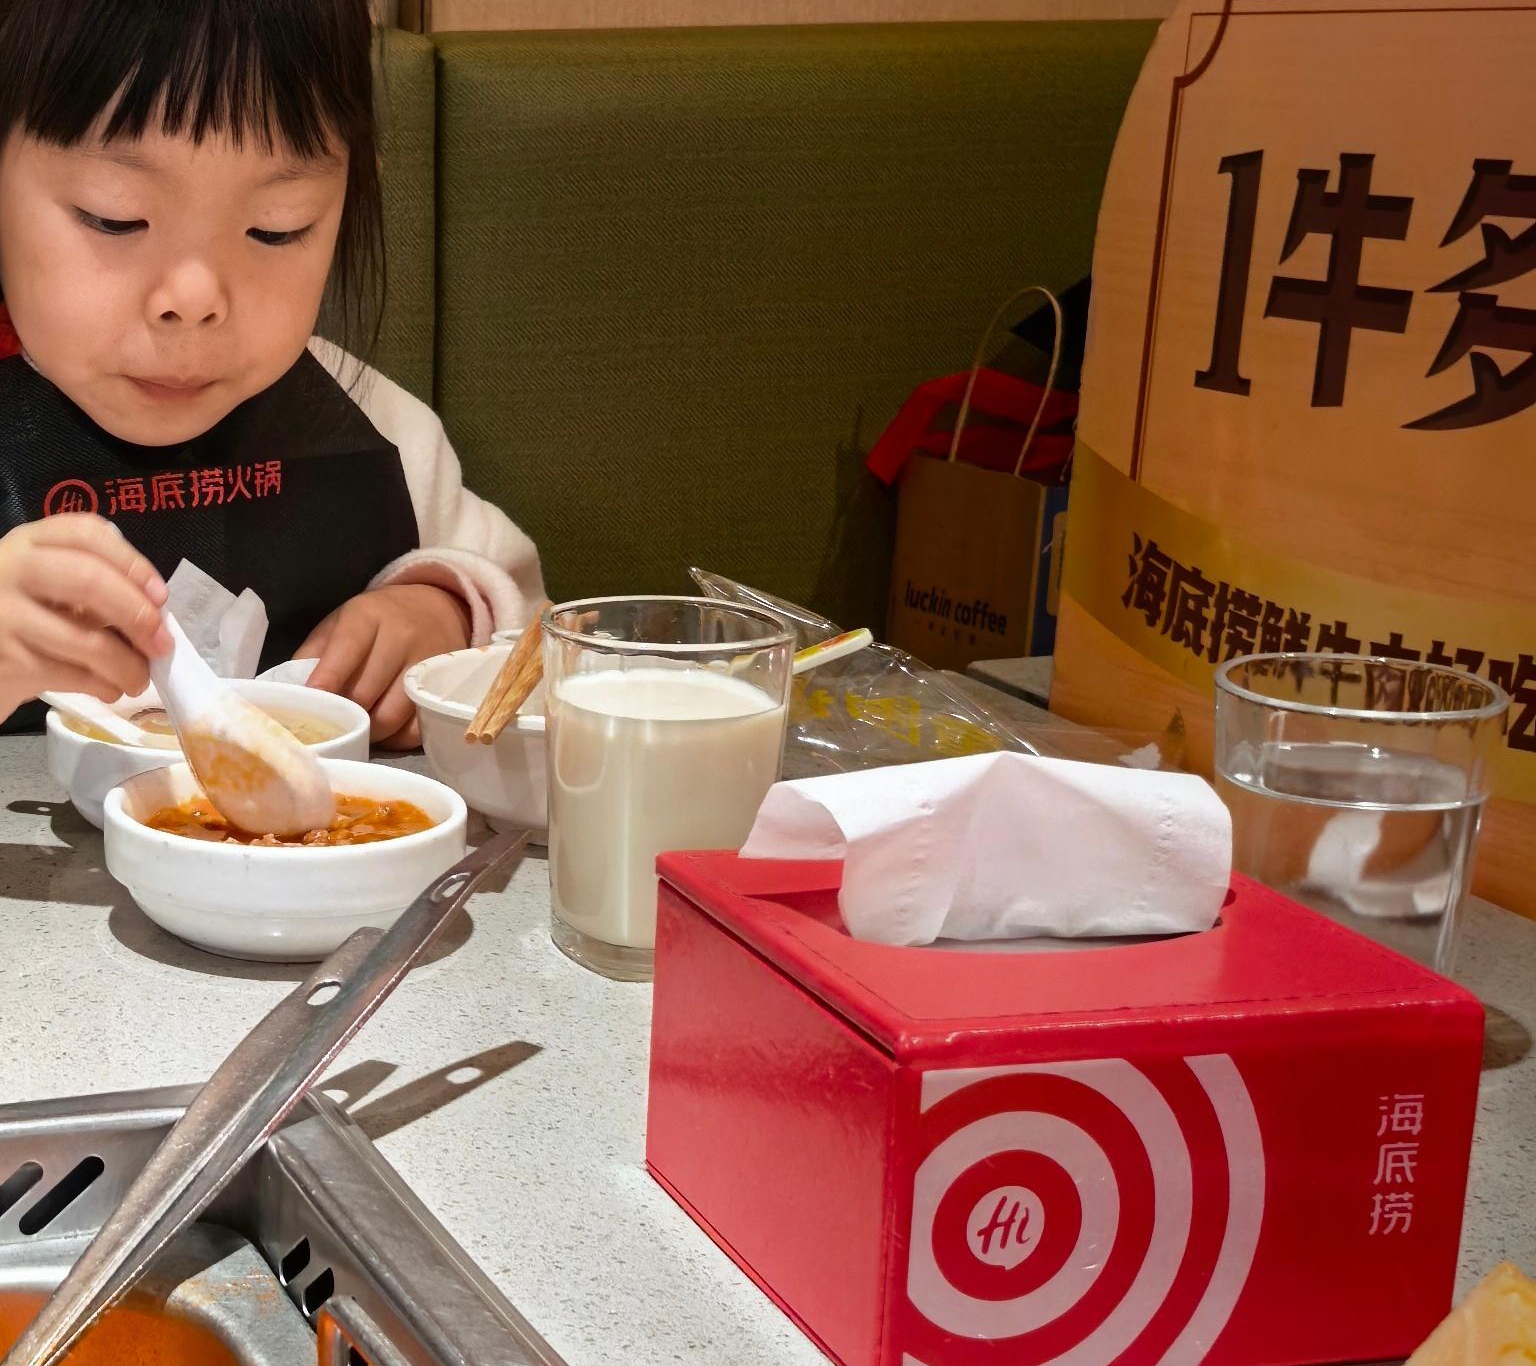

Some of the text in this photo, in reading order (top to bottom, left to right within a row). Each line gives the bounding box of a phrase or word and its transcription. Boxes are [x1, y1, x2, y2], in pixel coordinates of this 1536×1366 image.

[1194, 149, 1536, 432] 1件多
[105, 460, 282, 516] 海底捞火锅
[905, 579, 951, 619] luckin
[954, 599, 1007, 636] coffee
[1368, 1093, 1425, 1235] 海底捞
[976, 1195, 1031, 1255] Hi
